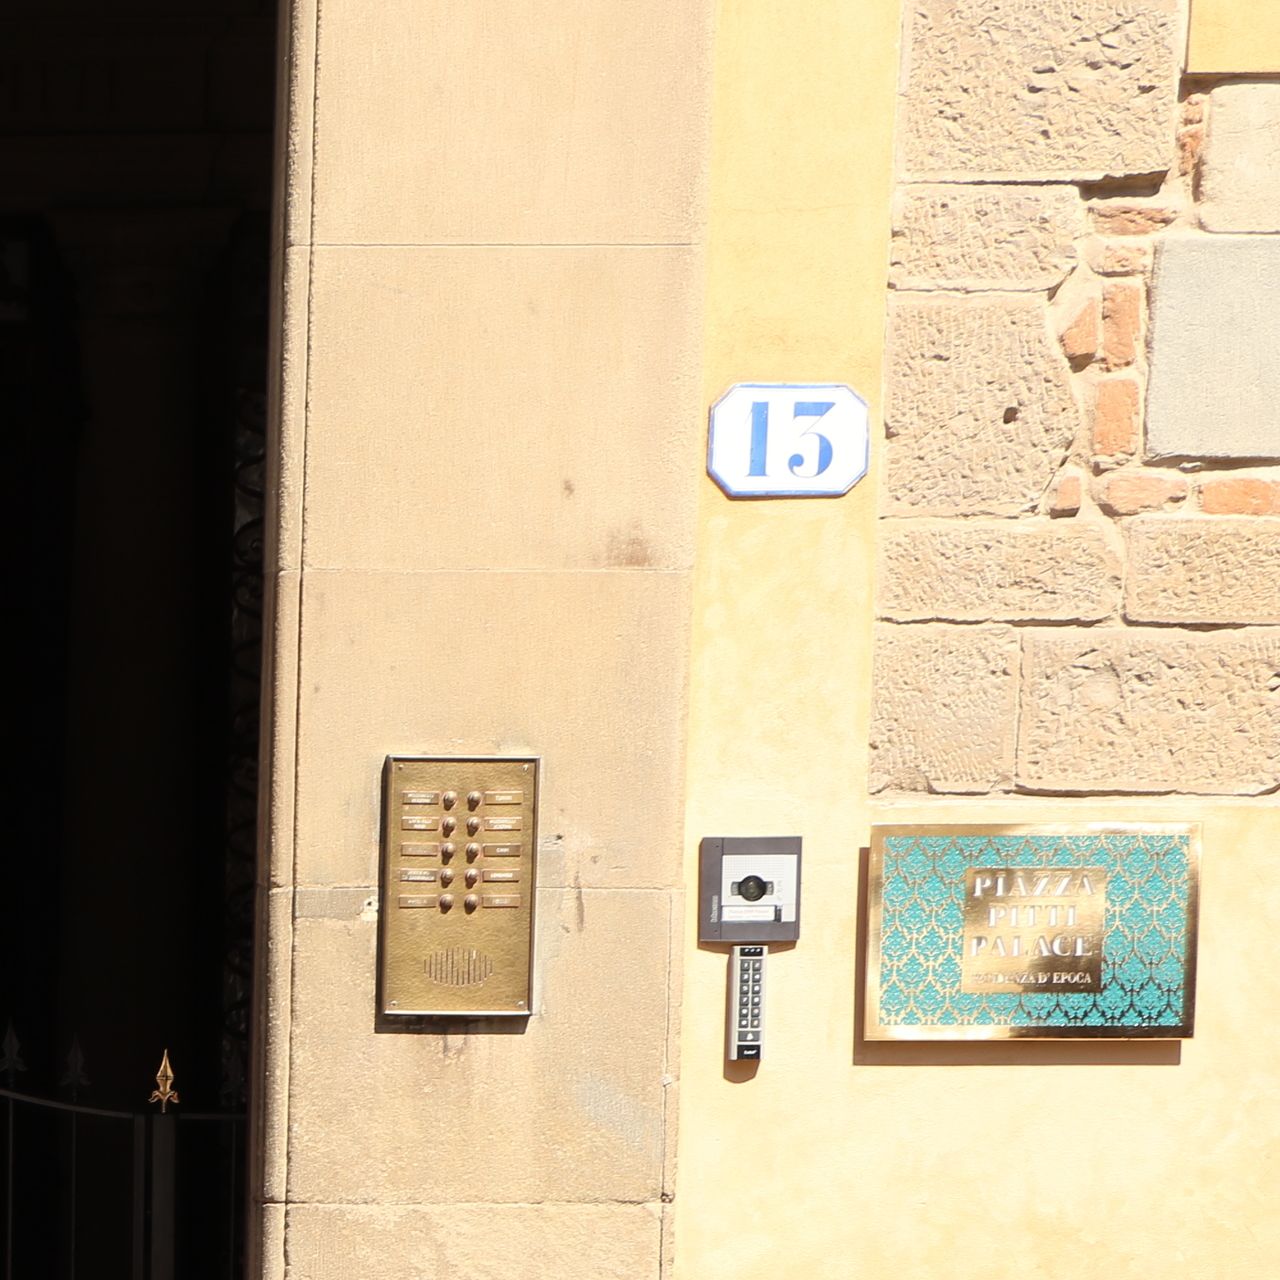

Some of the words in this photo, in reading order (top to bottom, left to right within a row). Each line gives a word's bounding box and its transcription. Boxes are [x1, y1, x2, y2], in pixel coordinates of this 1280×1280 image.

[972, 871, 1096, 897] PIAZZA
[987, 903, 1078, 928] PITTI
[969, 934, 1095, 957] PALACE
[1038, 972, 1051, 984] D'
[1052, 972, 1092, 984] EPOCA
